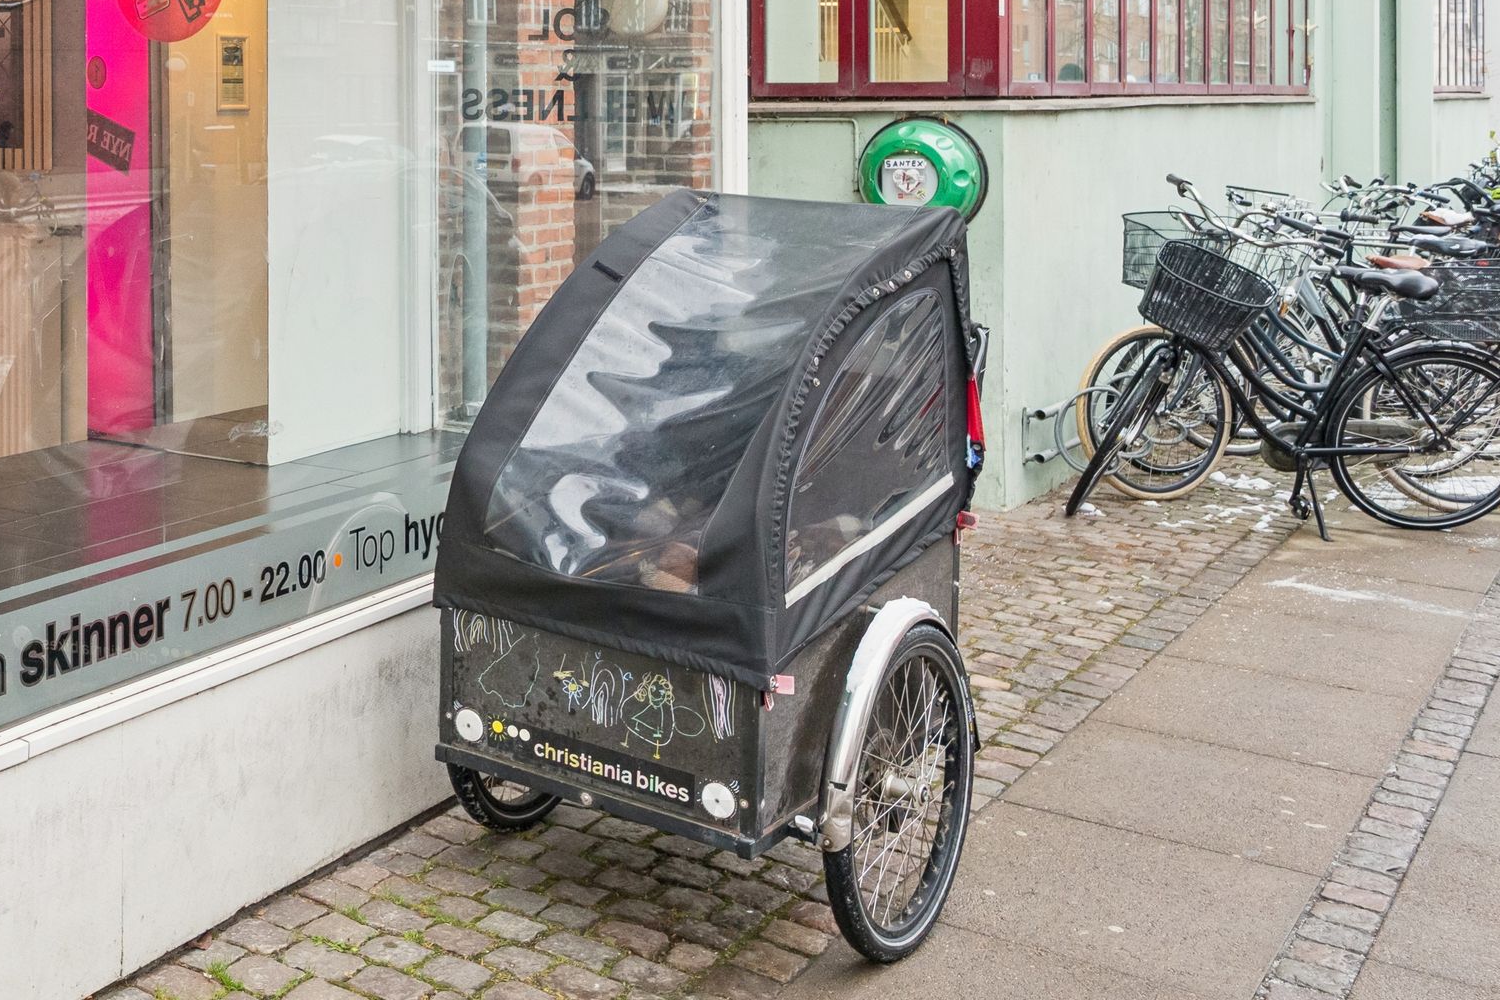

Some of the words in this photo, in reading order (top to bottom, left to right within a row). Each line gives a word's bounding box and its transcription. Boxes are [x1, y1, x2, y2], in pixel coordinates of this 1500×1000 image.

[885, 160, 924, 168] SANTEX
[19, 596, 171, 688] skinner
[181, 577, 236, 633] 7.00
[243, 587, 253, 600] -
[260, 549, 328, 604] 22.00
[349, 526, 395, 574] Top
[533, 742, 633, 785] christiania
[636, 770, 690, 803] bikes
